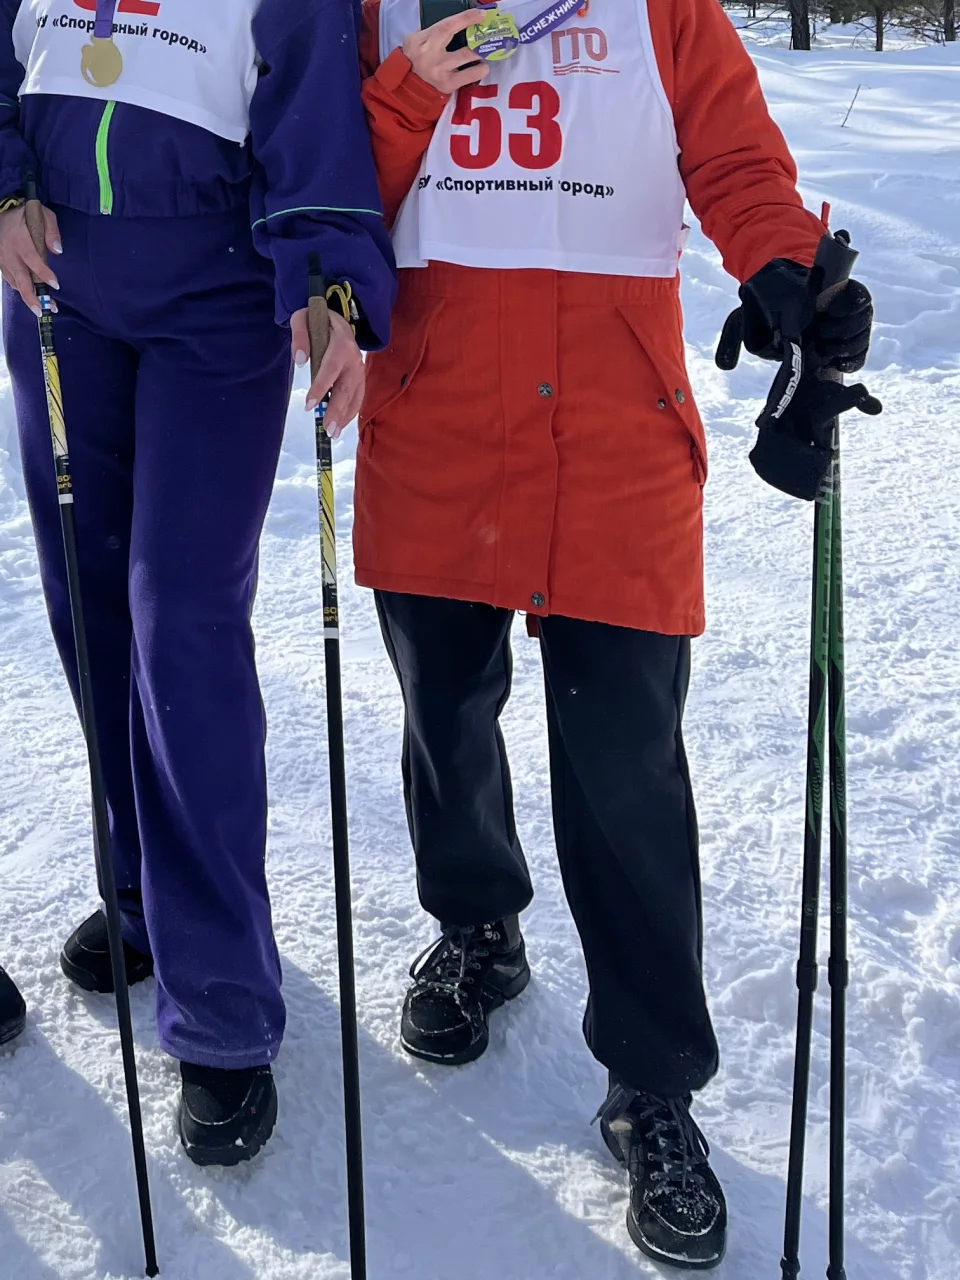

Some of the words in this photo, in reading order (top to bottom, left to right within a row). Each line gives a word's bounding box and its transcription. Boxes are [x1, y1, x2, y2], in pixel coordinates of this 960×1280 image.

[152, 27, 208, 54] город»
[550, 26, 608, 64] ГТО
[449, 80, 563, 170] 53
[435, 176, 554, 193] «Спортивный
[770, 341, 802, 419] BERGER
